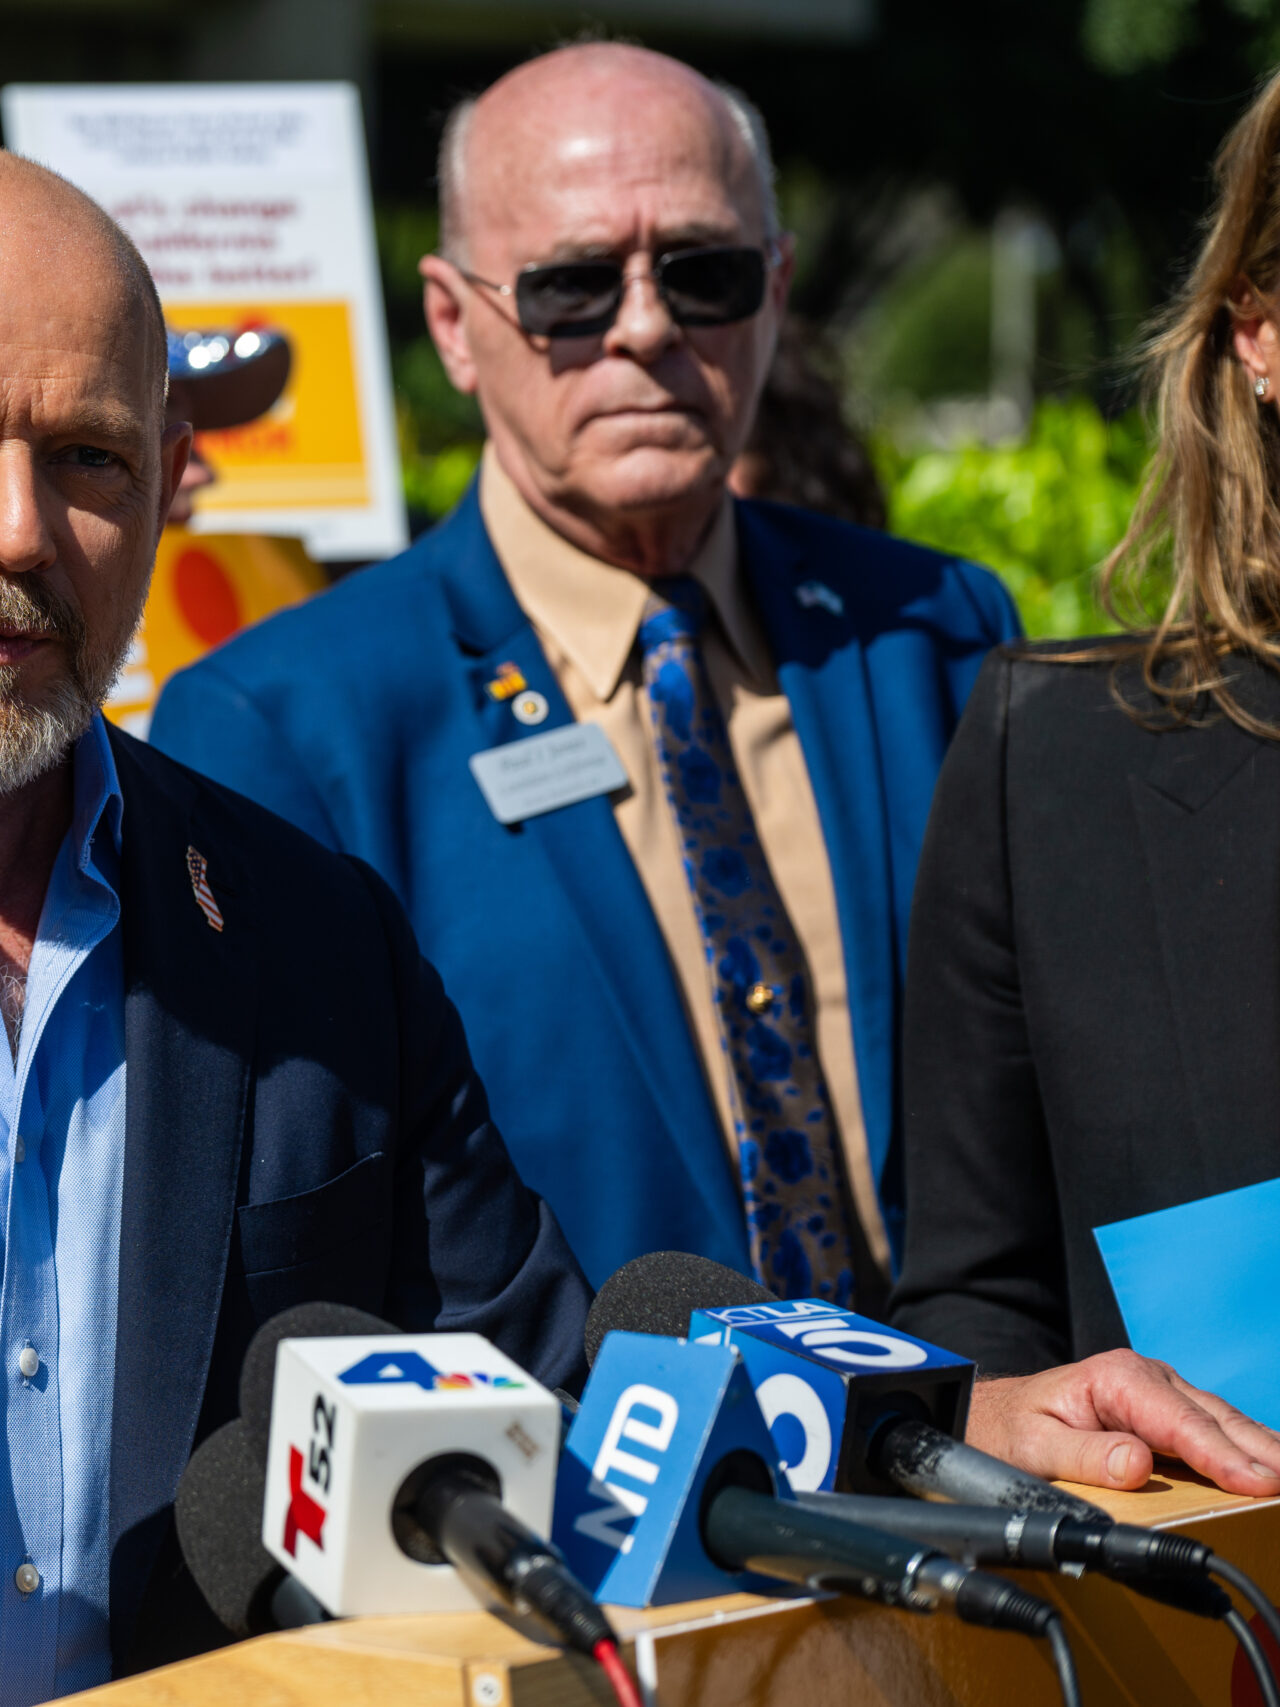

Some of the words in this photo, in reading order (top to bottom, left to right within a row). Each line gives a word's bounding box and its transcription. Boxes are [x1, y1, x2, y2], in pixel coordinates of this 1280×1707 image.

[706, 1302, 839, 1323] KTLA
[310, 1392, 336, 1495] 52
[574, 1384, 679, 1555] NTD
